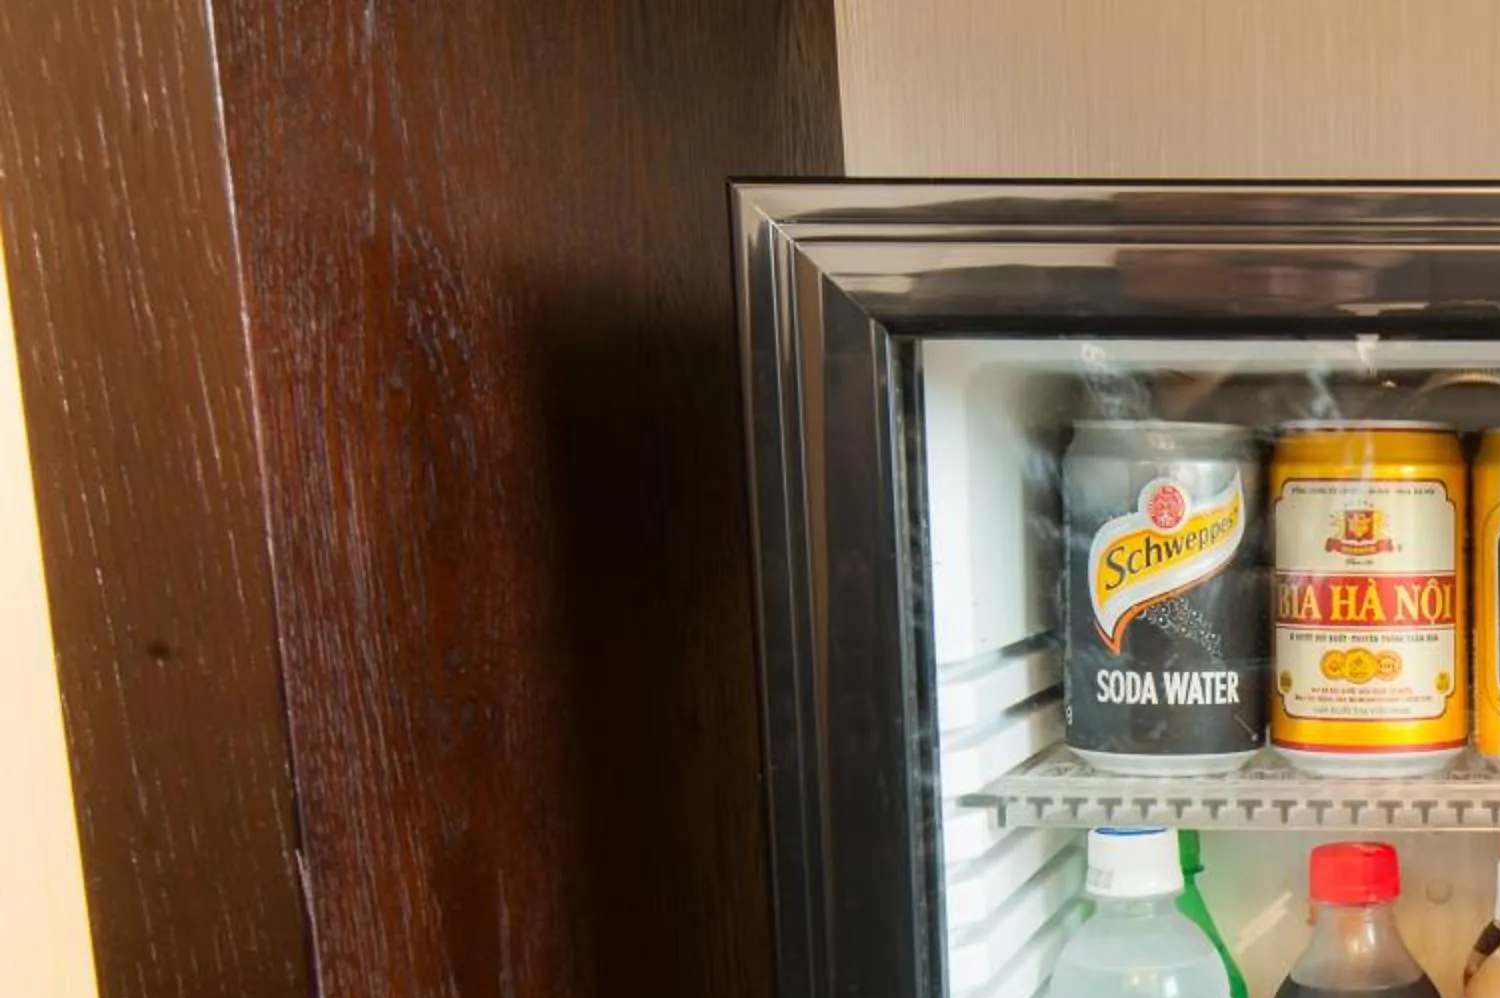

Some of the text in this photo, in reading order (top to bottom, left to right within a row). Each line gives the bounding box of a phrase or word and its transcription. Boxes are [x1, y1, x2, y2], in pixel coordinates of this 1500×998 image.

[1105, 513, 1236, 591] Schweppes
[1279, 577, 1454, 625] BIA HÀ NỘI
[1097, 669, 1240, 706] SODA WATER
